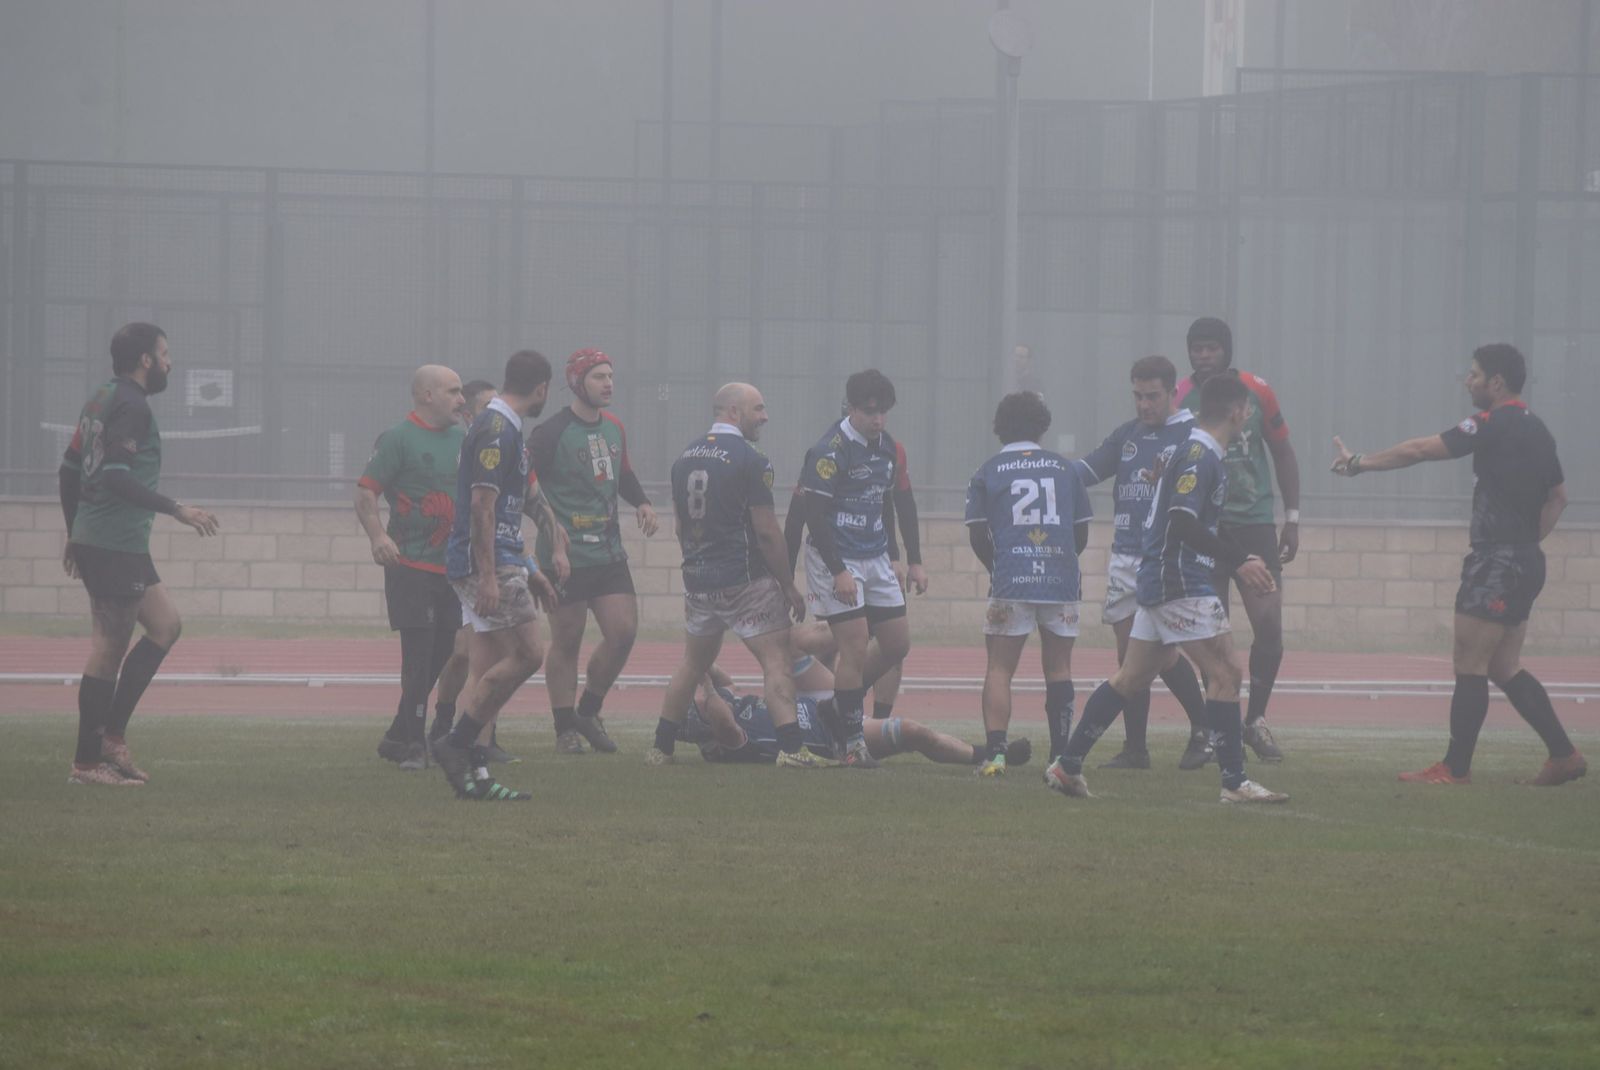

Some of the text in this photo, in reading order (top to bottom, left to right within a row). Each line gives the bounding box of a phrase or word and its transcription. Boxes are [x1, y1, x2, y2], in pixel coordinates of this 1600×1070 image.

[687, 469, 709, 519] 8
[1010, 477, 1061, 526] 21
[836, 511, 867, 527] gaza
